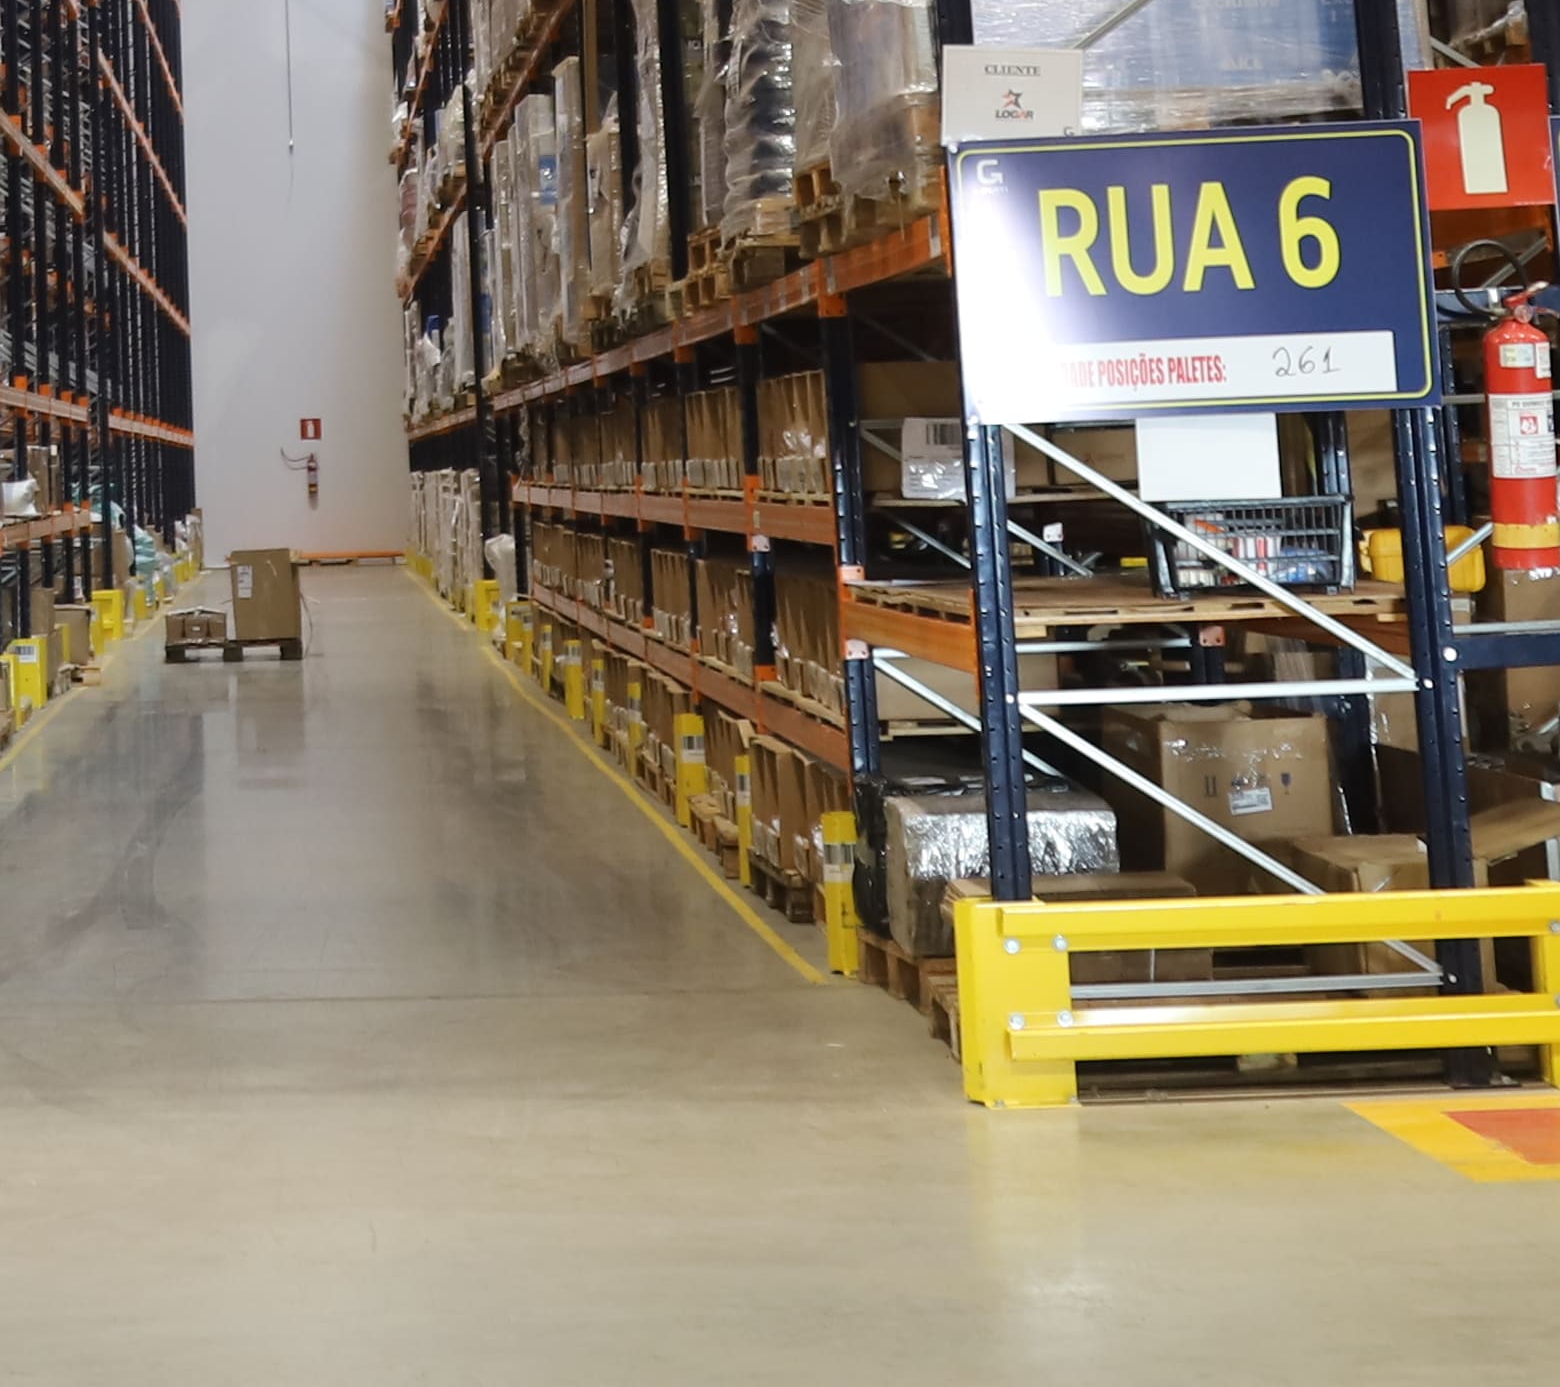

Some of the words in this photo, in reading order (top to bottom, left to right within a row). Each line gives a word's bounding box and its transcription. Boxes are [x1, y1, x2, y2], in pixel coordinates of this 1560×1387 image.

[984, 64, 1041, 77] CLIENTE
[995, 108, 1034, 120] LOGAR
[1038, 181, 1256, 297] RUA
[1278, 175, 1342, 289] 6
[1097, 353, 1165, 391] POSIÇÕES
[1167, 355, 1227, 385] PALETES:
[1272, 346, 1342, 377] 261
